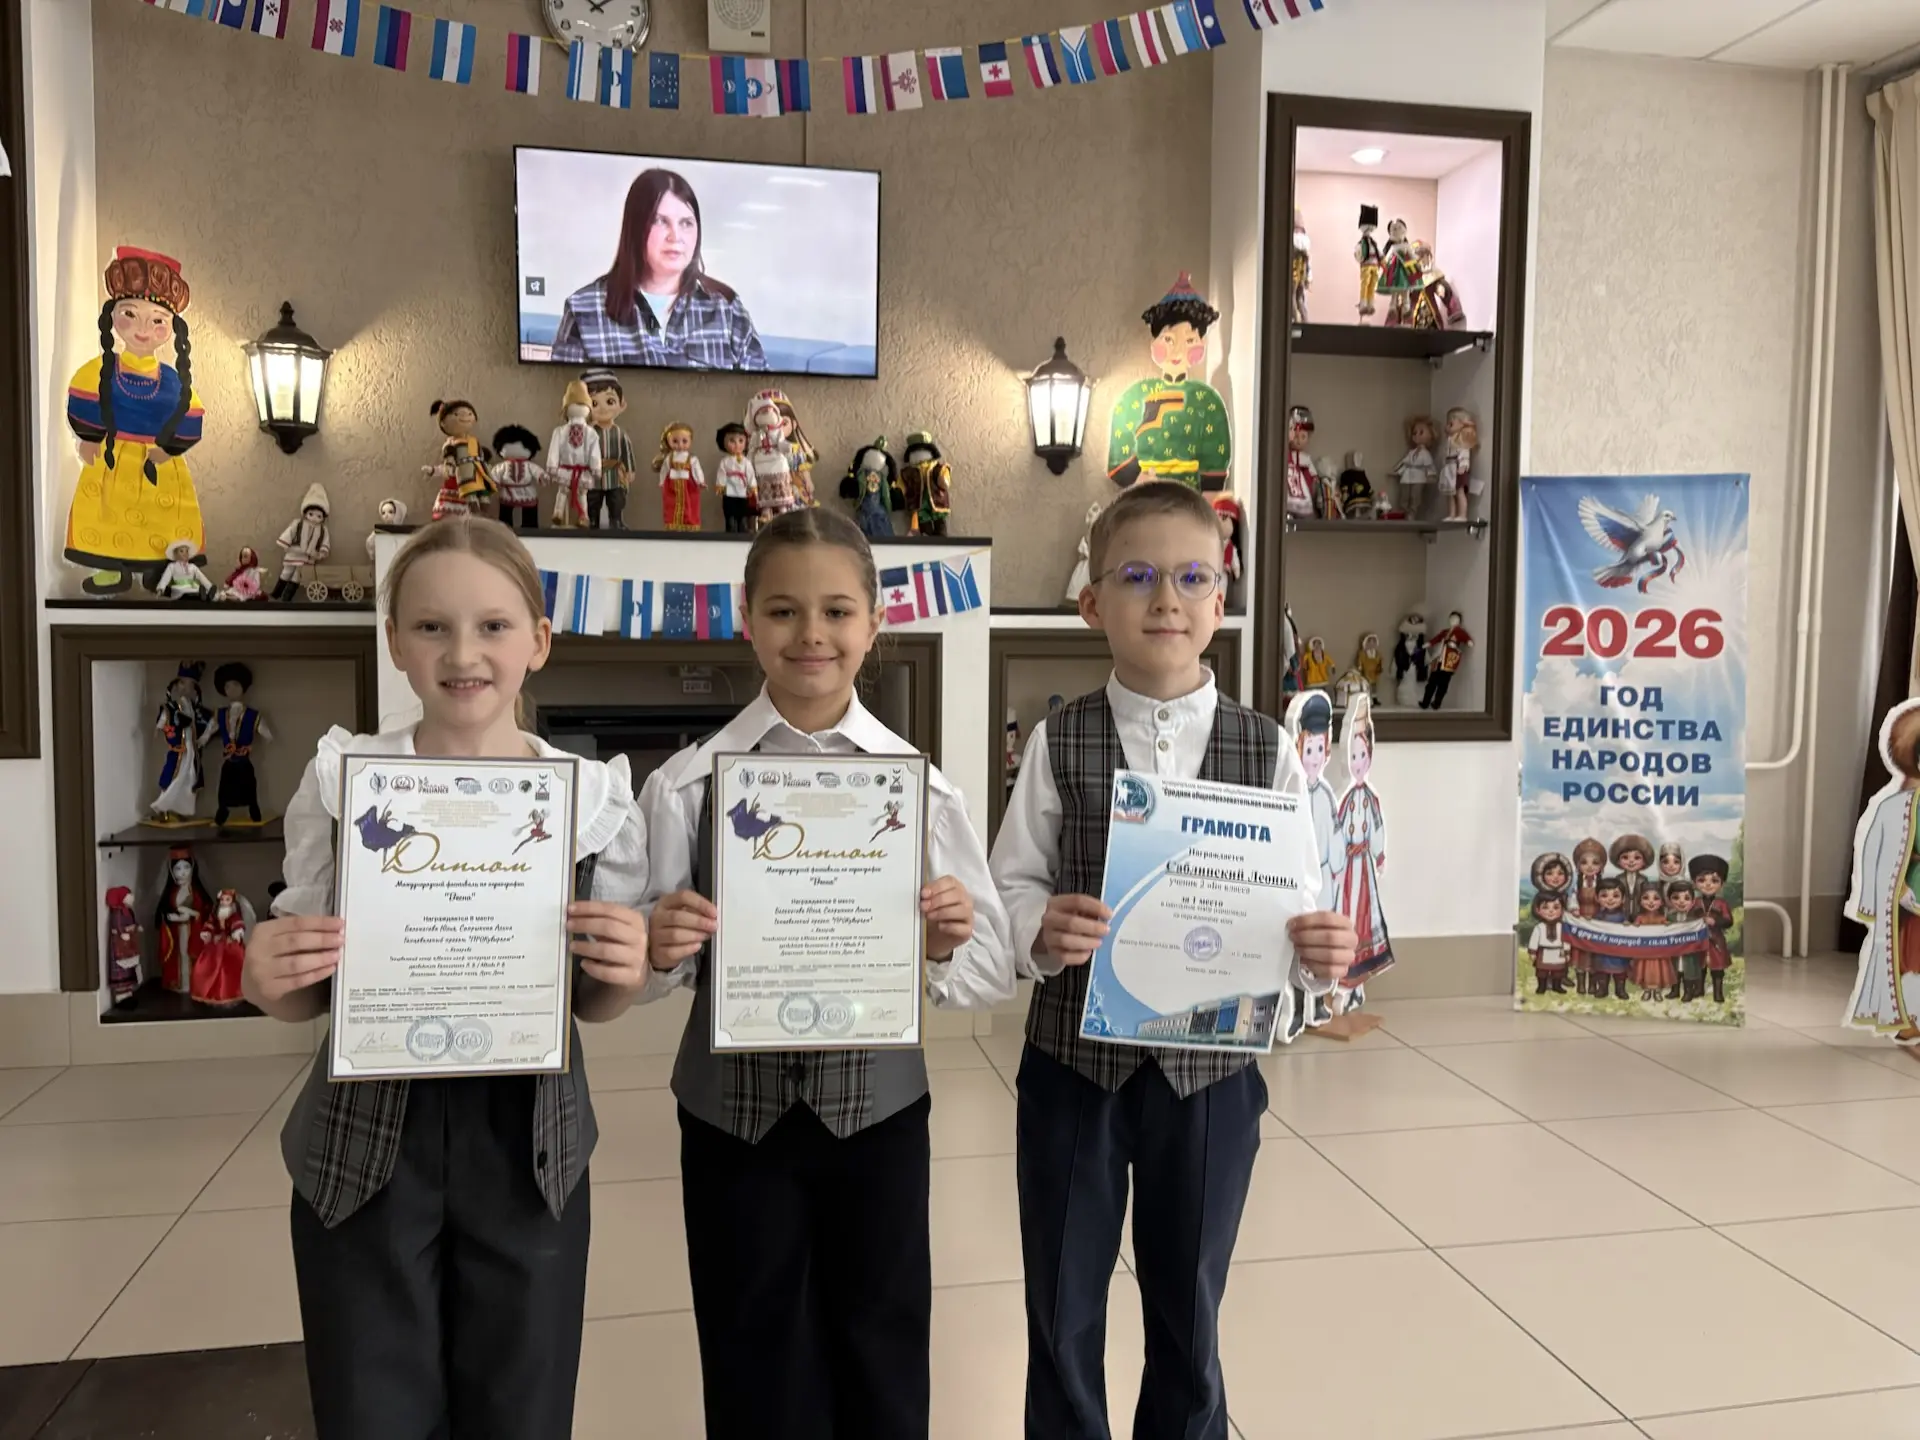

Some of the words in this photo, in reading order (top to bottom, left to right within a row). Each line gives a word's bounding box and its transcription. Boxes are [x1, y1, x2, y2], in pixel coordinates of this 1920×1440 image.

[1542, 606, 1725, 659] 2026
[1600, 685, 1664, 711] ГОД
[1543, 716, 1723, 742] ЕДИНСТВА
[1552, 749, 1712, 777] НАРОДОВ
[1562, 781, 1700, 806] РОССИИ
[752, 821, 888, 861] Диплом
[1180, 814, 1272, 844] ГРАМОТА
[380, 831, 532, 875] Диплом
[1188, 846, 1244, 863] Награждается
[1165, 860, 1245, 882] Саблинский
